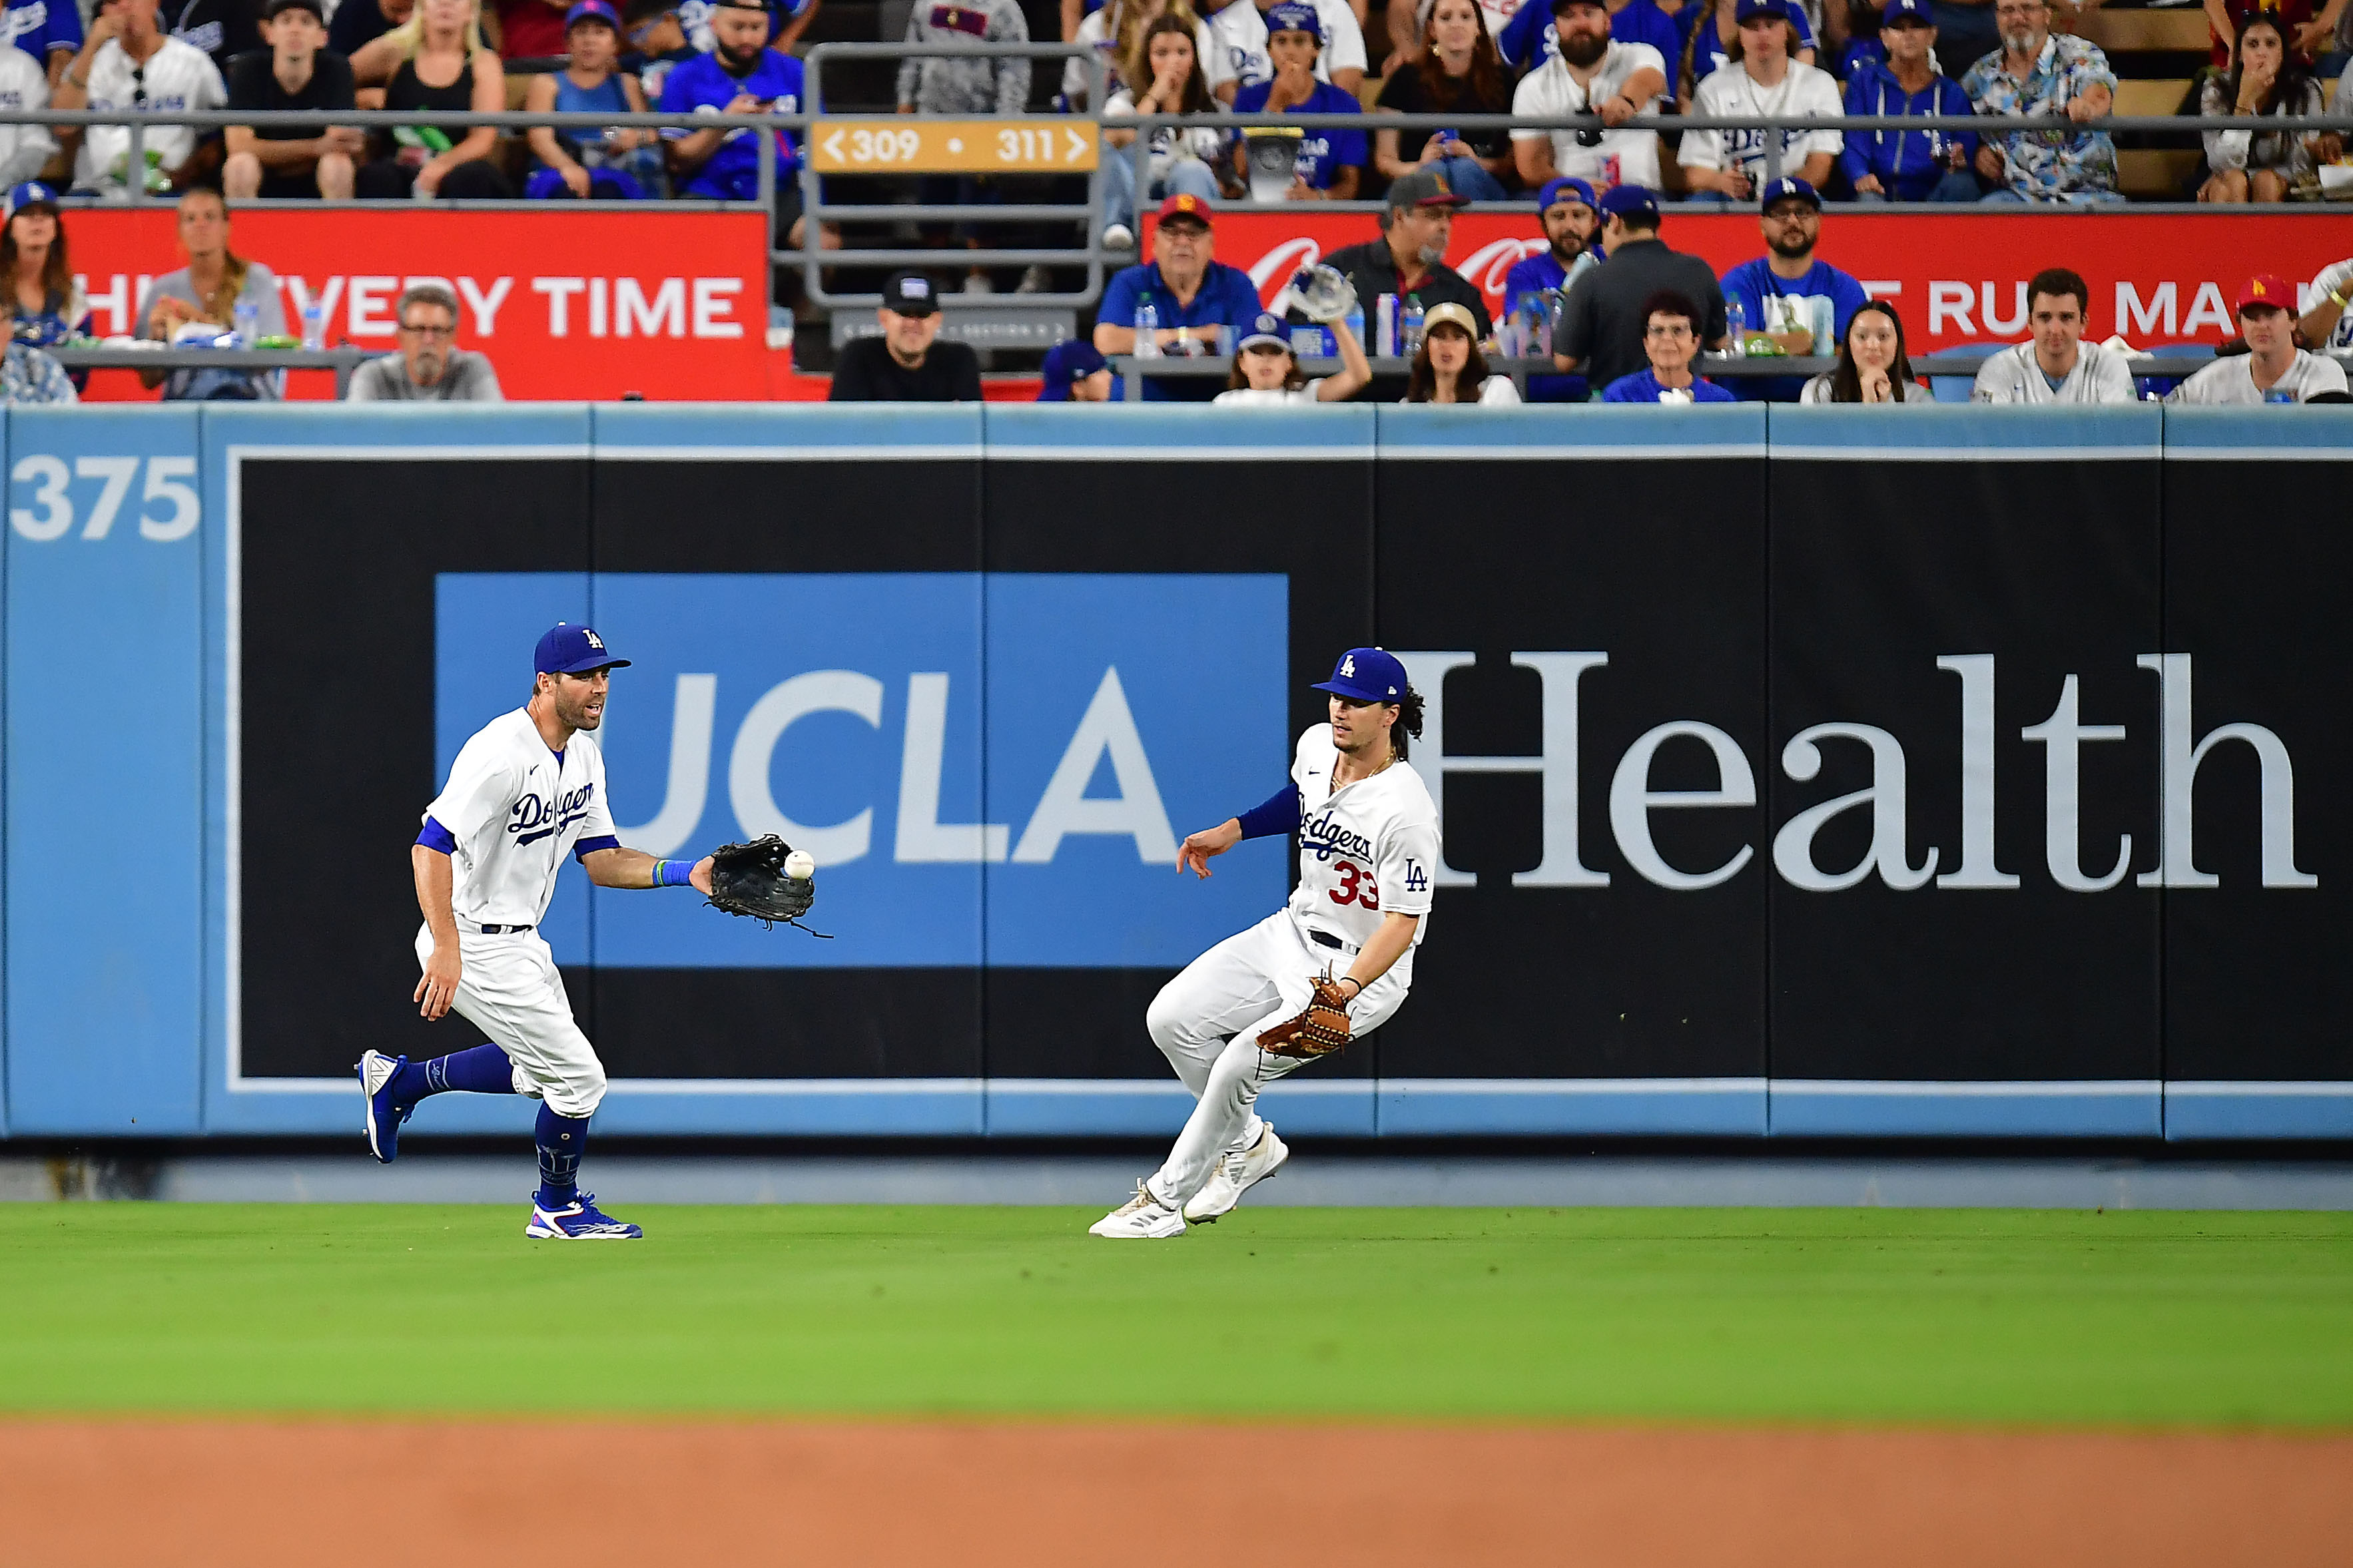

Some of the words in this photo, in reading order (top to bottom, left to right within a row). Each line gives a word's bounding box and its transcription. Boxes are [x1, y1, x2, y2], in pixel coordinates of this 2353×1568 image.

[852, 129, 919, 162] 309
[998, 129, 1053, 162] 311
[532, 276, 743, 338] TIME
[1929, 280, 2029, 336] RU
[10, 454, 201, 541] 375
[582, 629, 603, 649] LA
[1339, 654, 1356, 678] LA
[597, 666, 1179, 867] UCLA
[1392, 651, 2318, 892] Health
[1329, 860, 1379, 911] 33
[1405, 858, 1428, 892] LA
